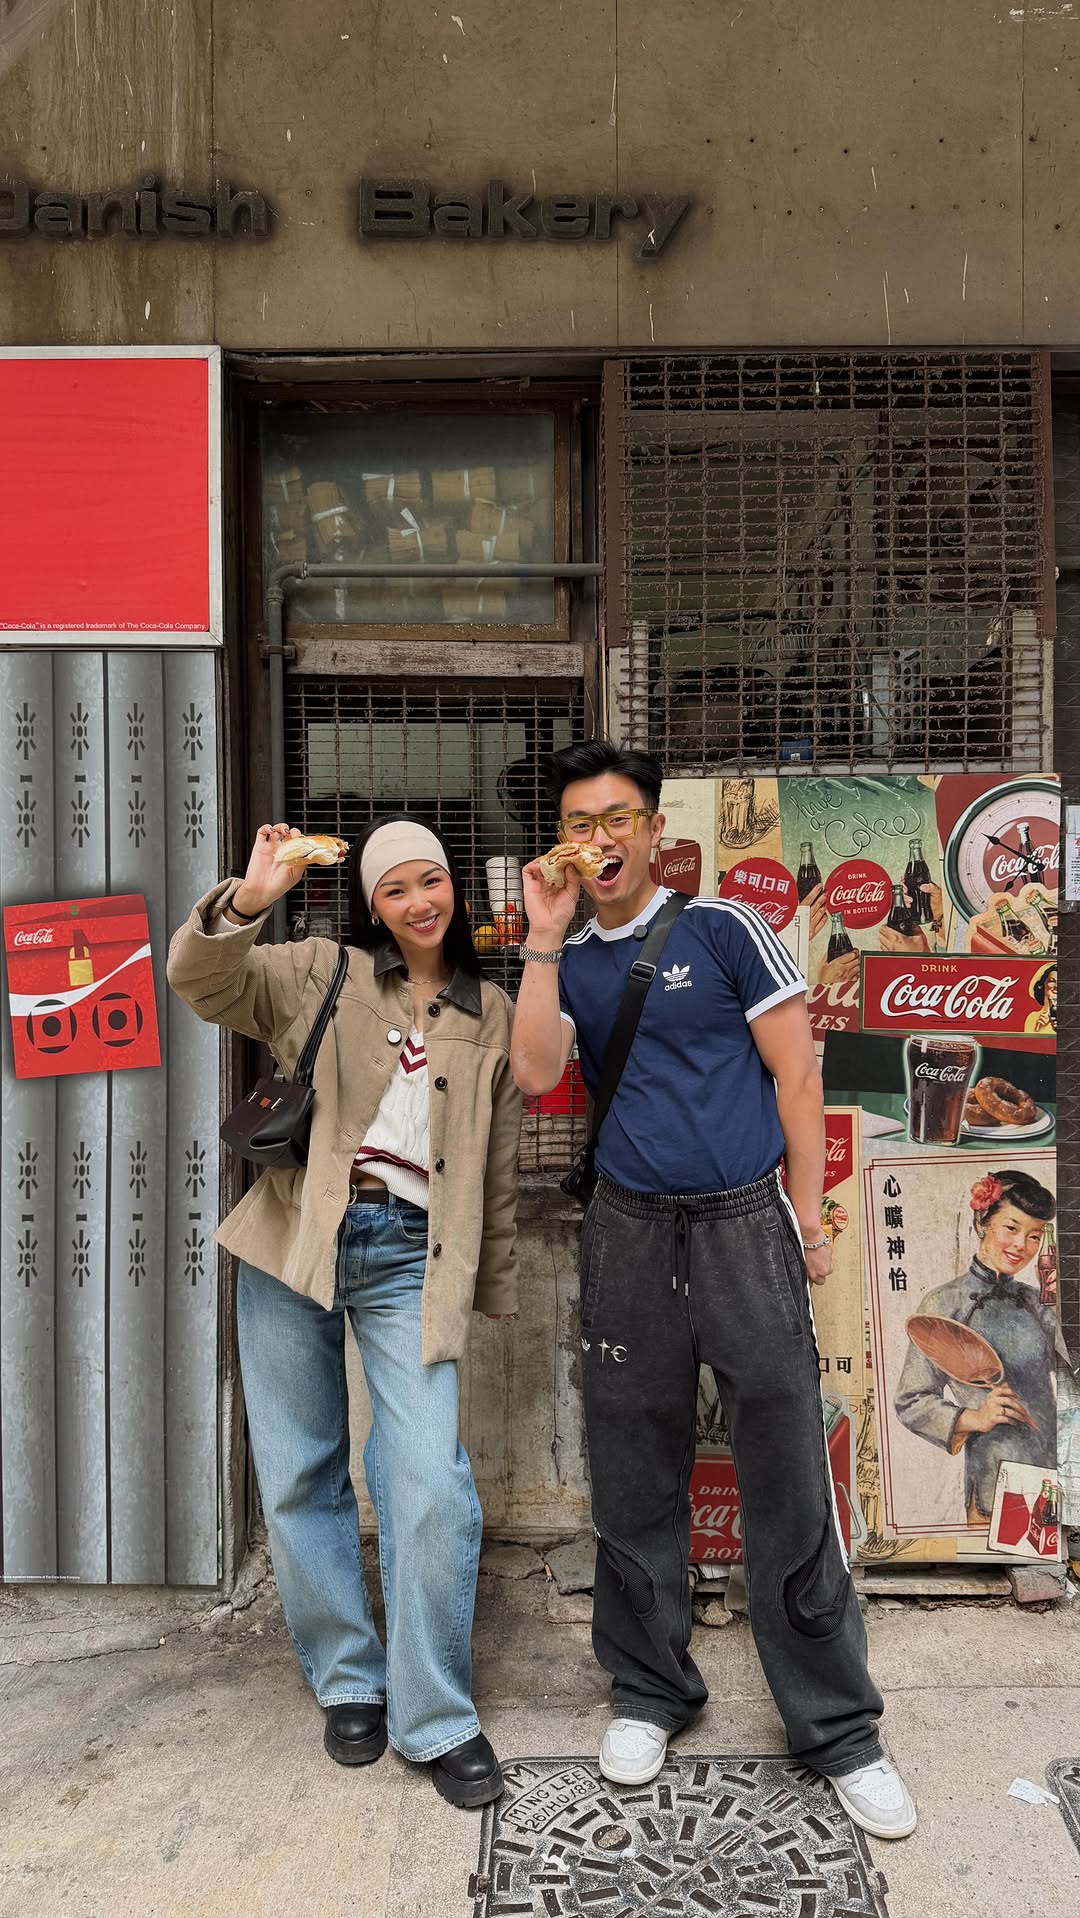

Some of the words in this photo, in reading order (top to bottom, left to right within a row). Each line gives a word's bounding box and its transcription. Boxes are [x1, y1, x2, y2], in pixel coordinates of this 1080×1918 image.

[358, 178, 693, 260] Bakery
[53, 622, 84, 631] registered
[824, 811, 921, 858] Coke
[829, 880, 886, 907] Coca-Cola
[852, 906, 878, 914] BOTTLES
[14, 927, 55, 947] Coca-Cola
[921, 964, 958, 973] DRINK
[664, 980, 693, 991] adidas
[880, 973, 1021, 1020] Coca-Cola
[914, 1062, 969, 1082] Coca-Cola
[883, 1174, 908, 1291] 心曠神怡
[699, 1486, 740, 1496] DRIN
[508, 1789, 550, 1820] MING
[550, 1770, 588, 1791] LEE
